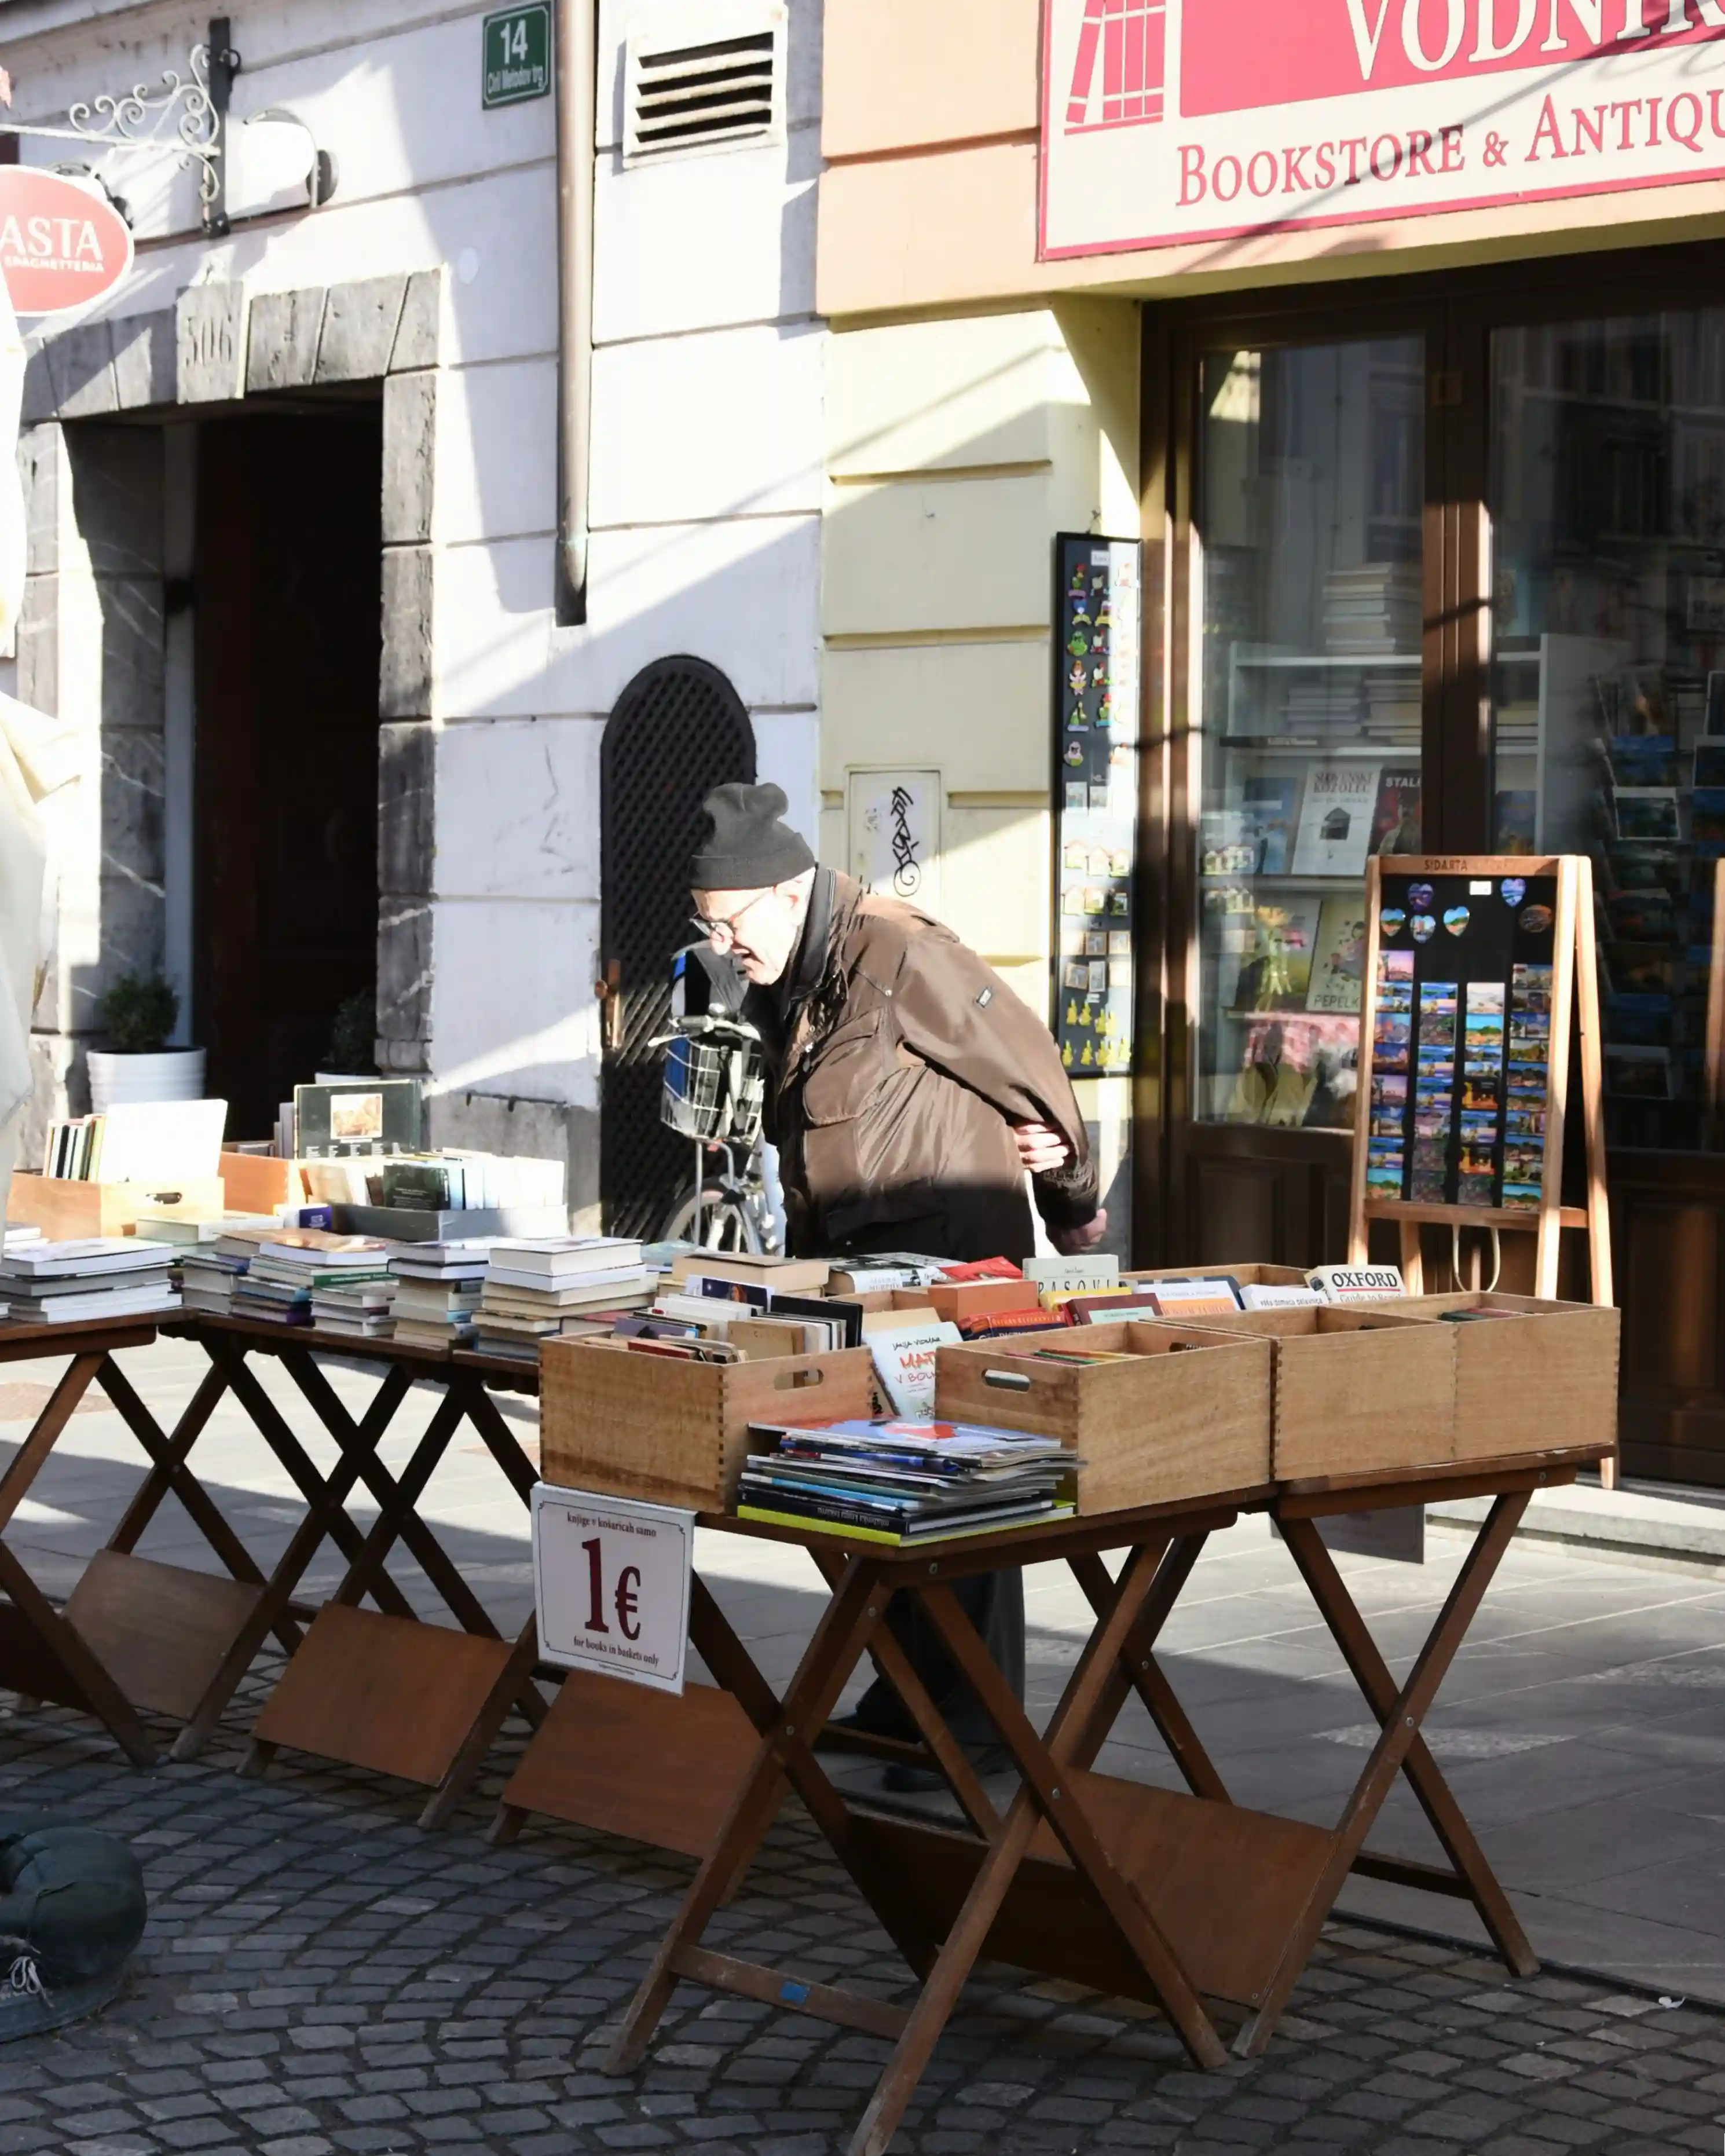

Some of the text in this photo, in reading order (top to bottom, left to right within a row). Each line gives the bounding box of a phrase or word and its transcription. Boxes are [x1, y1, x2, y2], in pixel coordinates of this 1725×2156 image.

[500, 18, 528, 65] 14
[1175, 123, 1466, 206] BOOKSTORE
[1482, 131, 1509, 167] &
[1332, 1272, 1398, 1288] OXFORD
[567, 1511, 590, 1528] knjige
[636, 1527, 657, 1537] samo
[574, 1635, 660, 1669] for books in baskets only
